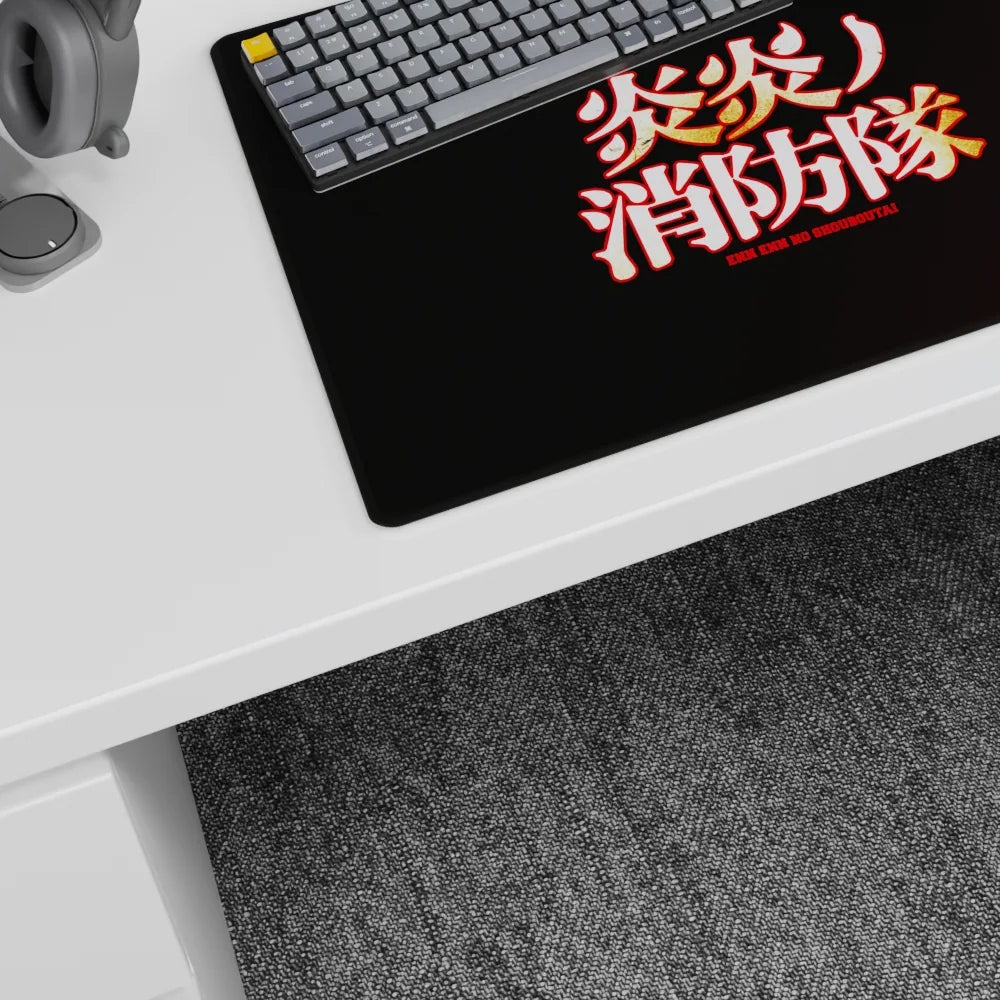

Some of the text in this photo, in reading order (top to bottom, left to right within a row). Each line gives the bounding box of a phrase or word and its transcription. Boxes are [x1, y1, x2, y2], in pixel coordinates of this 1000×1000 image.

[577, 13, 886, 179] 炎炎ノ
[320, 120, 334, 128] shift
[390, 113, 418, 129] command
[355, 131, 375, 142] option
[314, 147, 335, 159] control
[577, 83, 988, 283] 消防隊
[725, 202, 900, 267] ENN ENN NO SHOUBOUTAI
